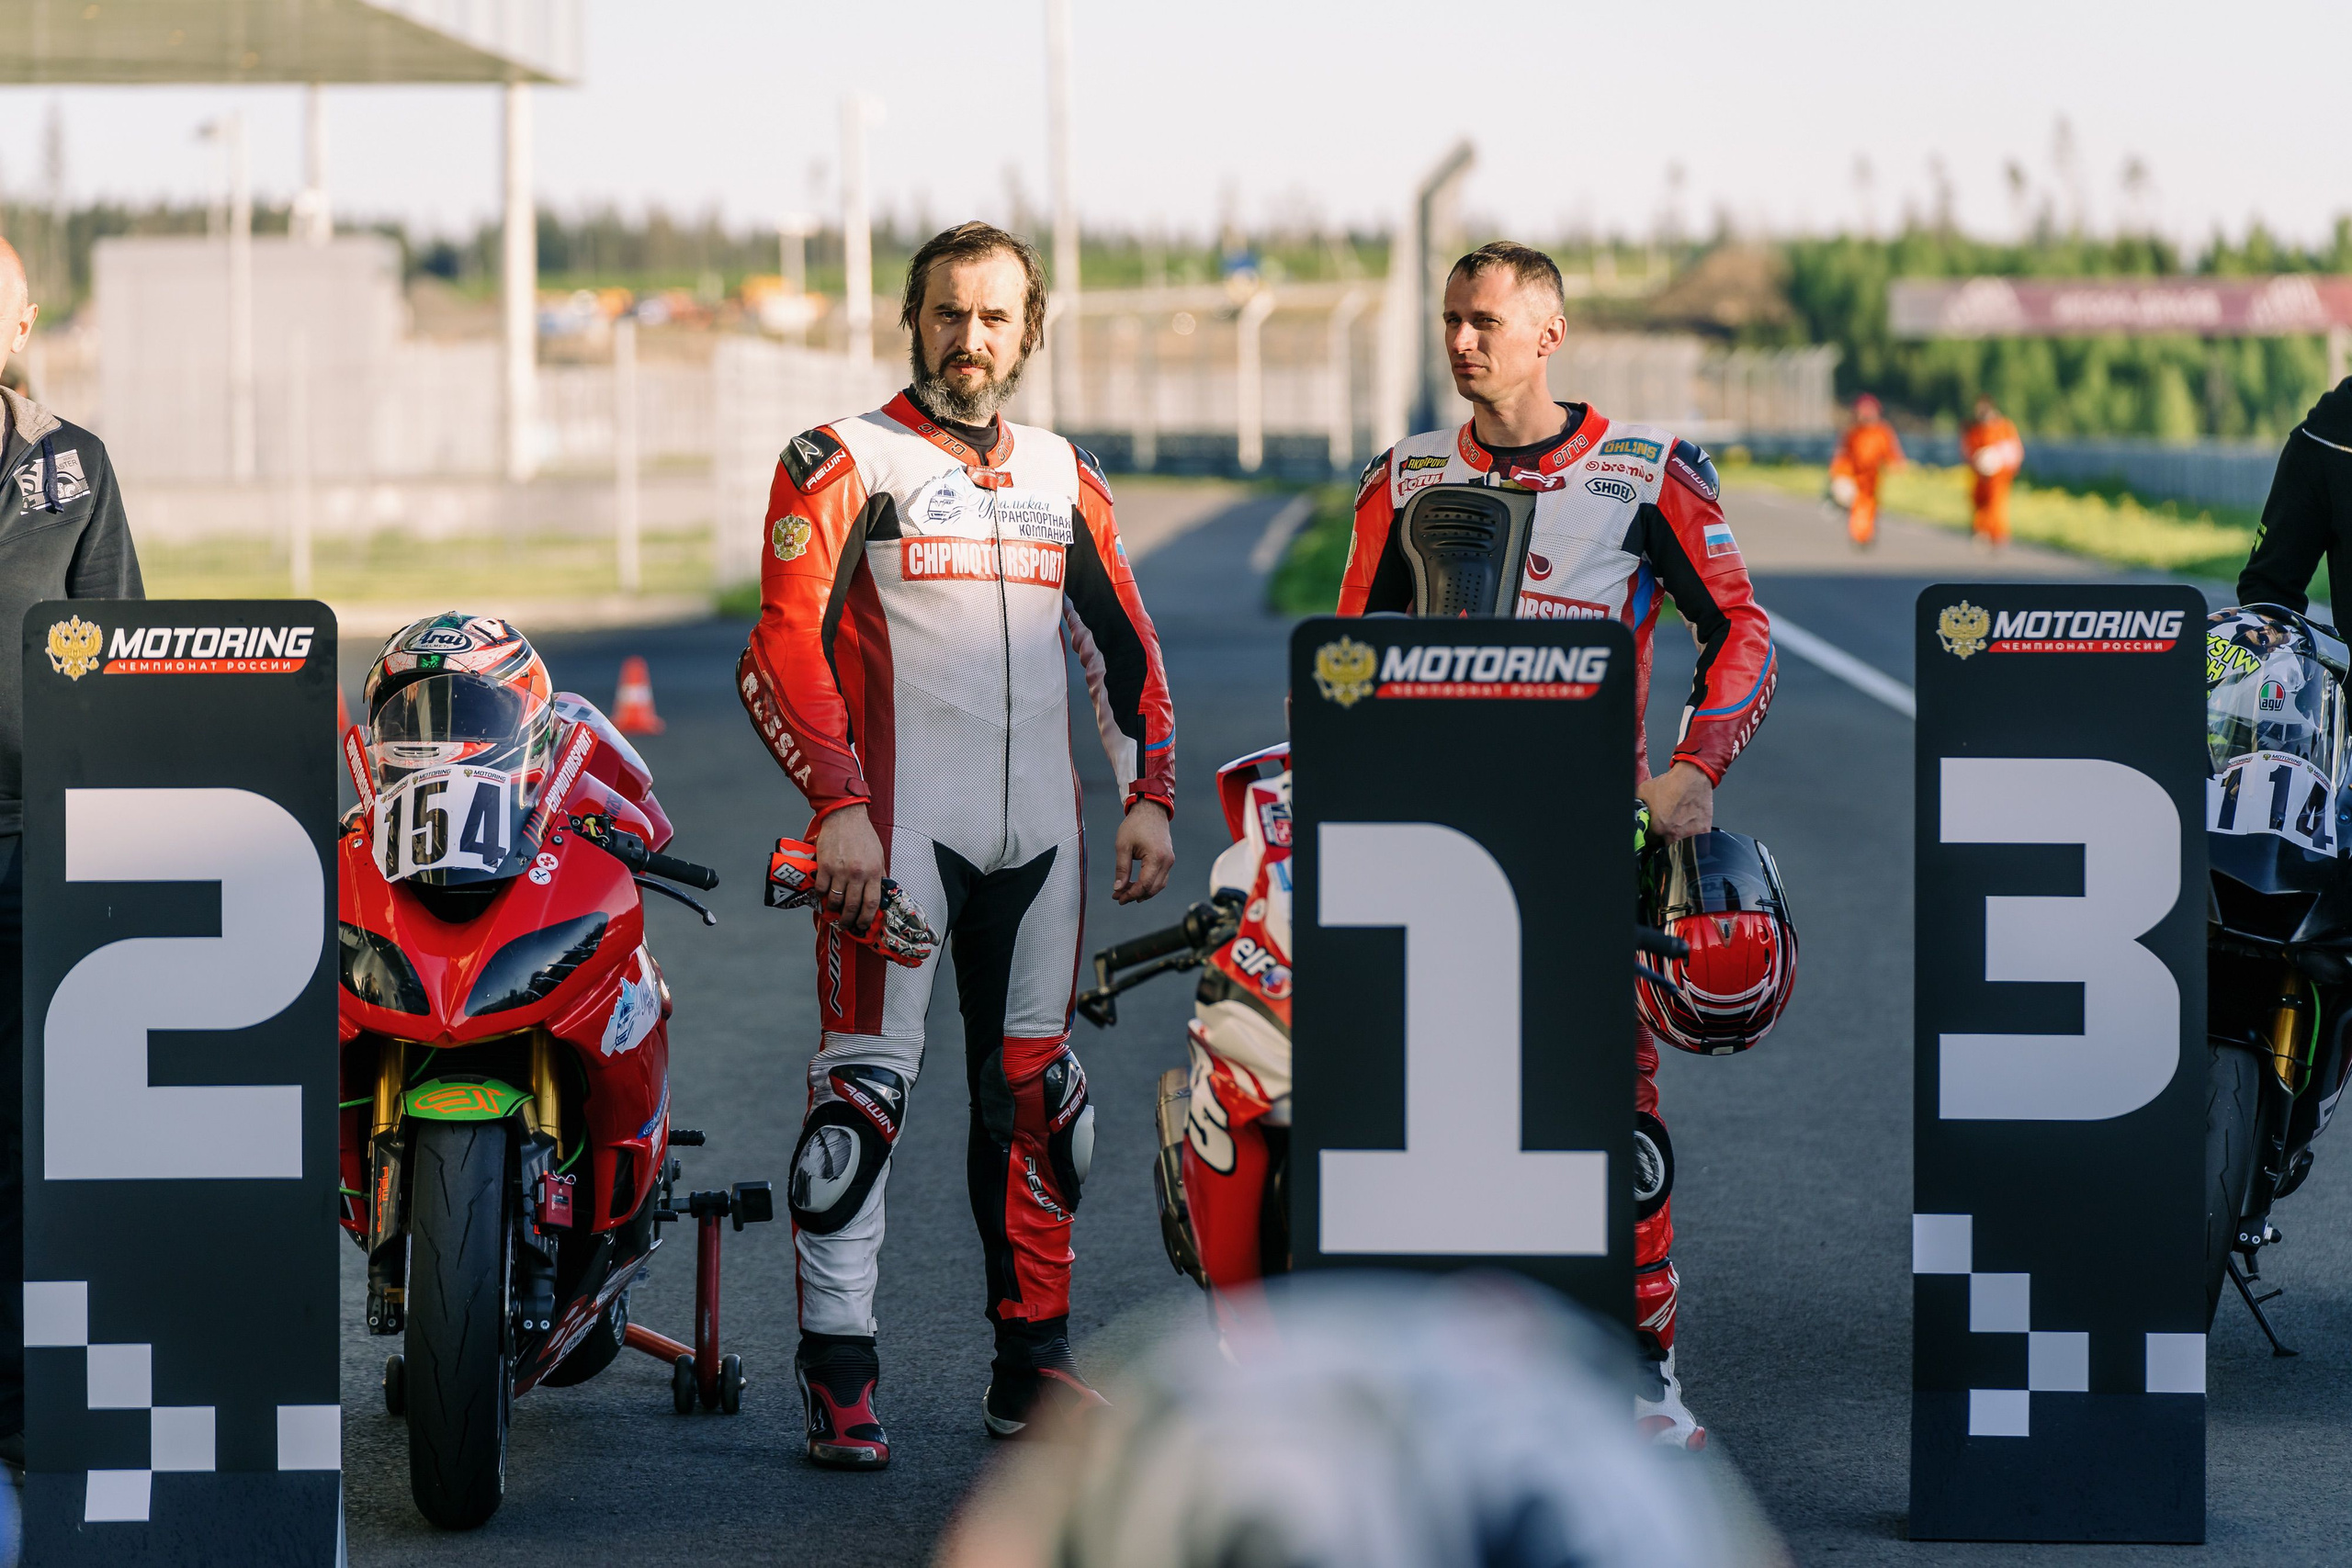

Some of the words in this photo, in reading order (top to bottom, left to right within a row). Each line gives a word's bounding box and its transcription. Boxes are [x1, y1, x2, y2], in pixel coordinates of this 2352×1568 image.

[918, 423, 967, 456] OTTO
[1553, 434, 1589, 467] OTTO
[1604, 441, 1657, 460] ÖHLINS
[806, 450, 846, 490] REWIN
[1601, 461, 1655, 483] brembo
[1672, 457, 1713, 496] REWIN
[1593, 480, 1631, 500] SHOEI
[1019, 524, 1073, 542] КОМПАНИЯ
[908, 542, 1063, 582] CHPMOTORSPORT
[419, 627, 465, 646] Arai
[1992, 610, 2186, 638] MOTORING
[107, 626, 315, 659] MOTORING
[118, 661, 217, 671] ЧЕМПИОНАТ
[227, 661, 292, 671] РОССИИ
[1379, 646, 1611, 683] MOTORING
[2261, 698, 2283, 712] agv
[419, 769, 452, 780] MOTORING
[473, 770, 506, 783] MOTORING
[545, 728, 594, 813] CHPMOTORSPORT
[2271, 754, 2302, 766] MOTORING
[2217, 764, 2334, 851] 114
[383, 780, 507, 879] 154
[1939, 757, 2182, 1121] 3
[1230, 937, 1278, 976] elf
[43, 787, 325, 1180] 2
[1317, 821, 1609, 1255] 1
[843, 1082, 895, 1134] REWIN
[1024, 1156, 1069, 1222] REWIN
